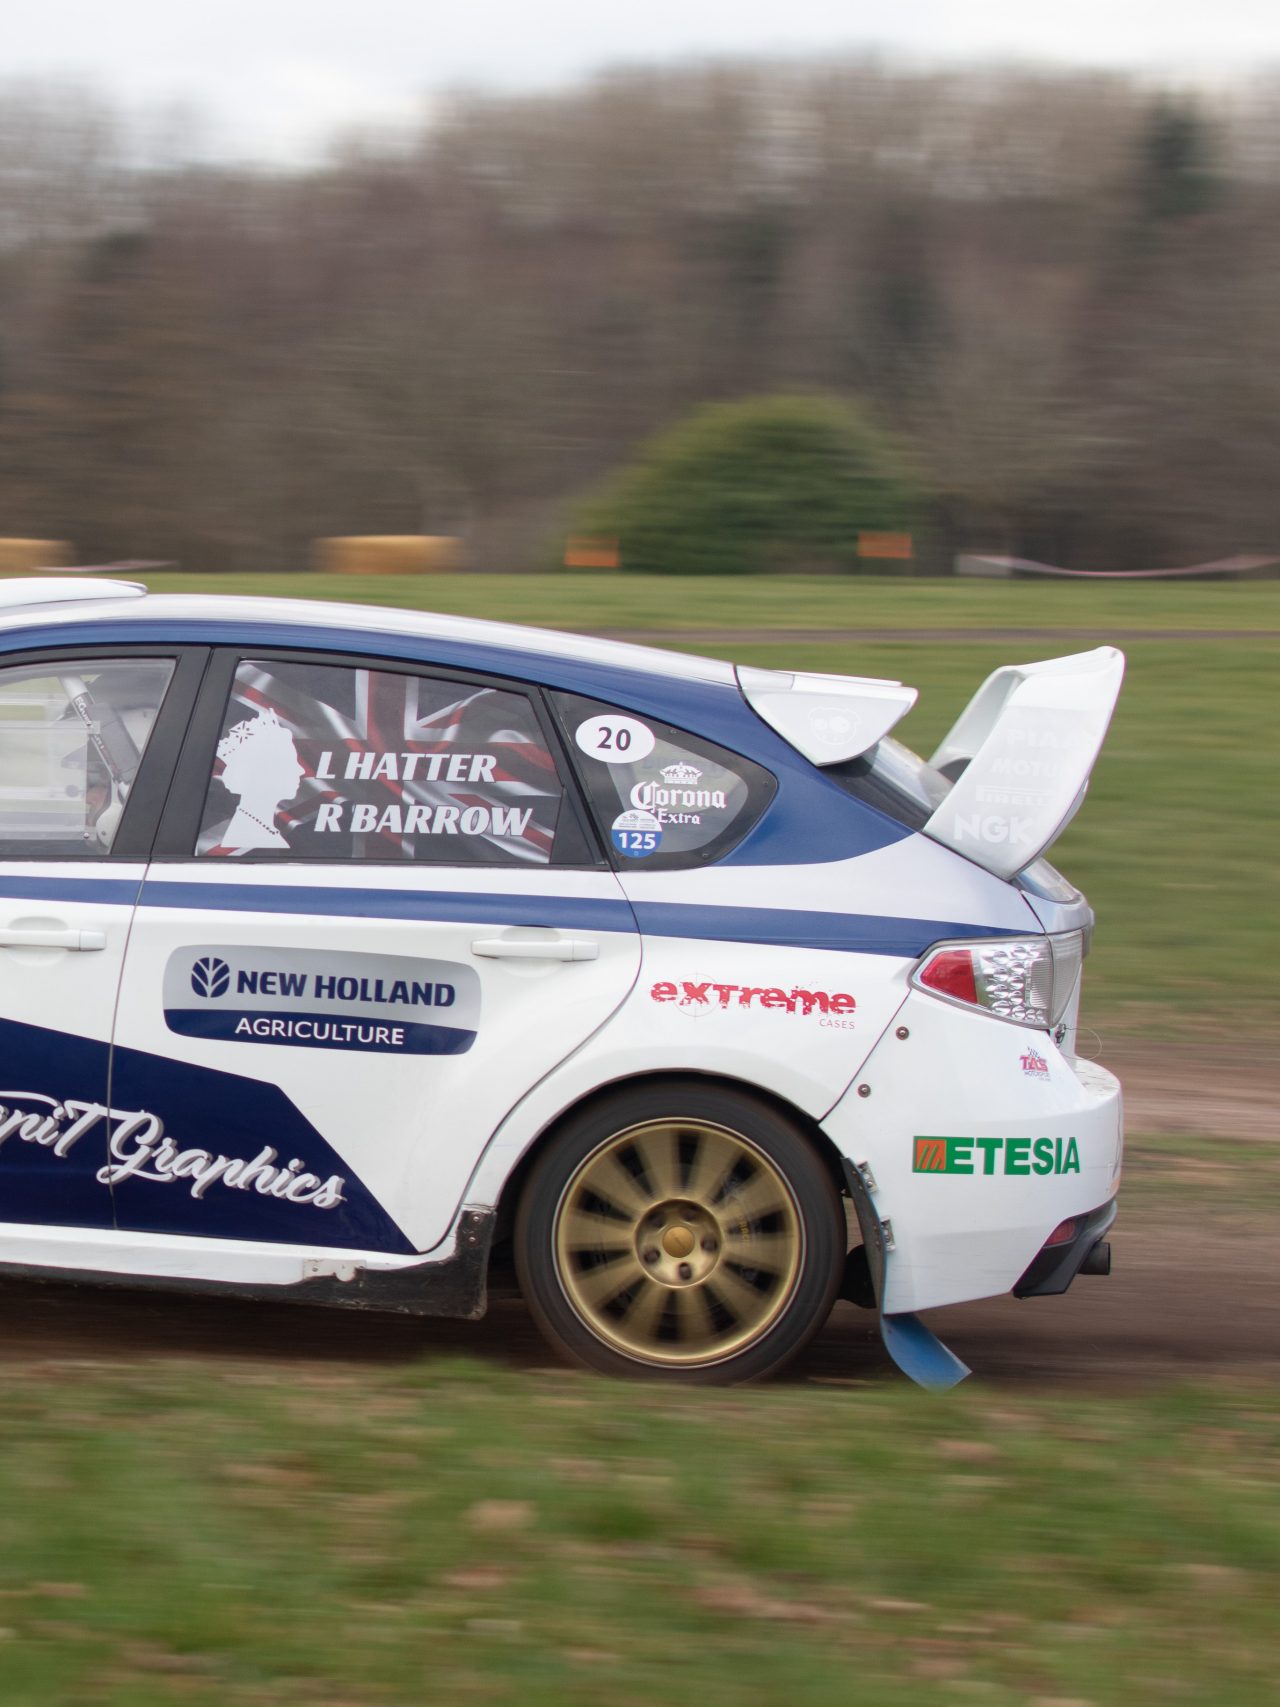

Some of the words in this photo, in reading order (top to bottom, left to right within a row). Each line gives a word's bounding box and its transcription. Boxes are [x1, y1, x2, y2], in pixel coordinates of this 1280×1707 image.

[597, 726, 631, 751] 20
[315, 751, 336, 780] L
[344, 752, 497, 783] HATTER
[989, 757, 1063, 777] MOTU
[630, 781, 727, 813] Corona
[976, 785, 1052, 807] PIRELL
[314, 803, 343, 833] R
[349, 804, 533, 836] BARROW
[658, 808, 701, 825] Extra
[953, 813, 1035, 845] NGK
[618, 832, 656, 850] 125
[237, 970, 307, 997] NEW
[314, 976, 455, 1007] HOLLAND
[235, 1017, 405, 1045] AGRICULTURE
[819, 1018, 855, 1030] CASES
[1019, 1055, 1048, 1072] TAS
[96, 1110, 347, 1209] Graphics
[946, 1137, 1080, 1176] ETESIA
